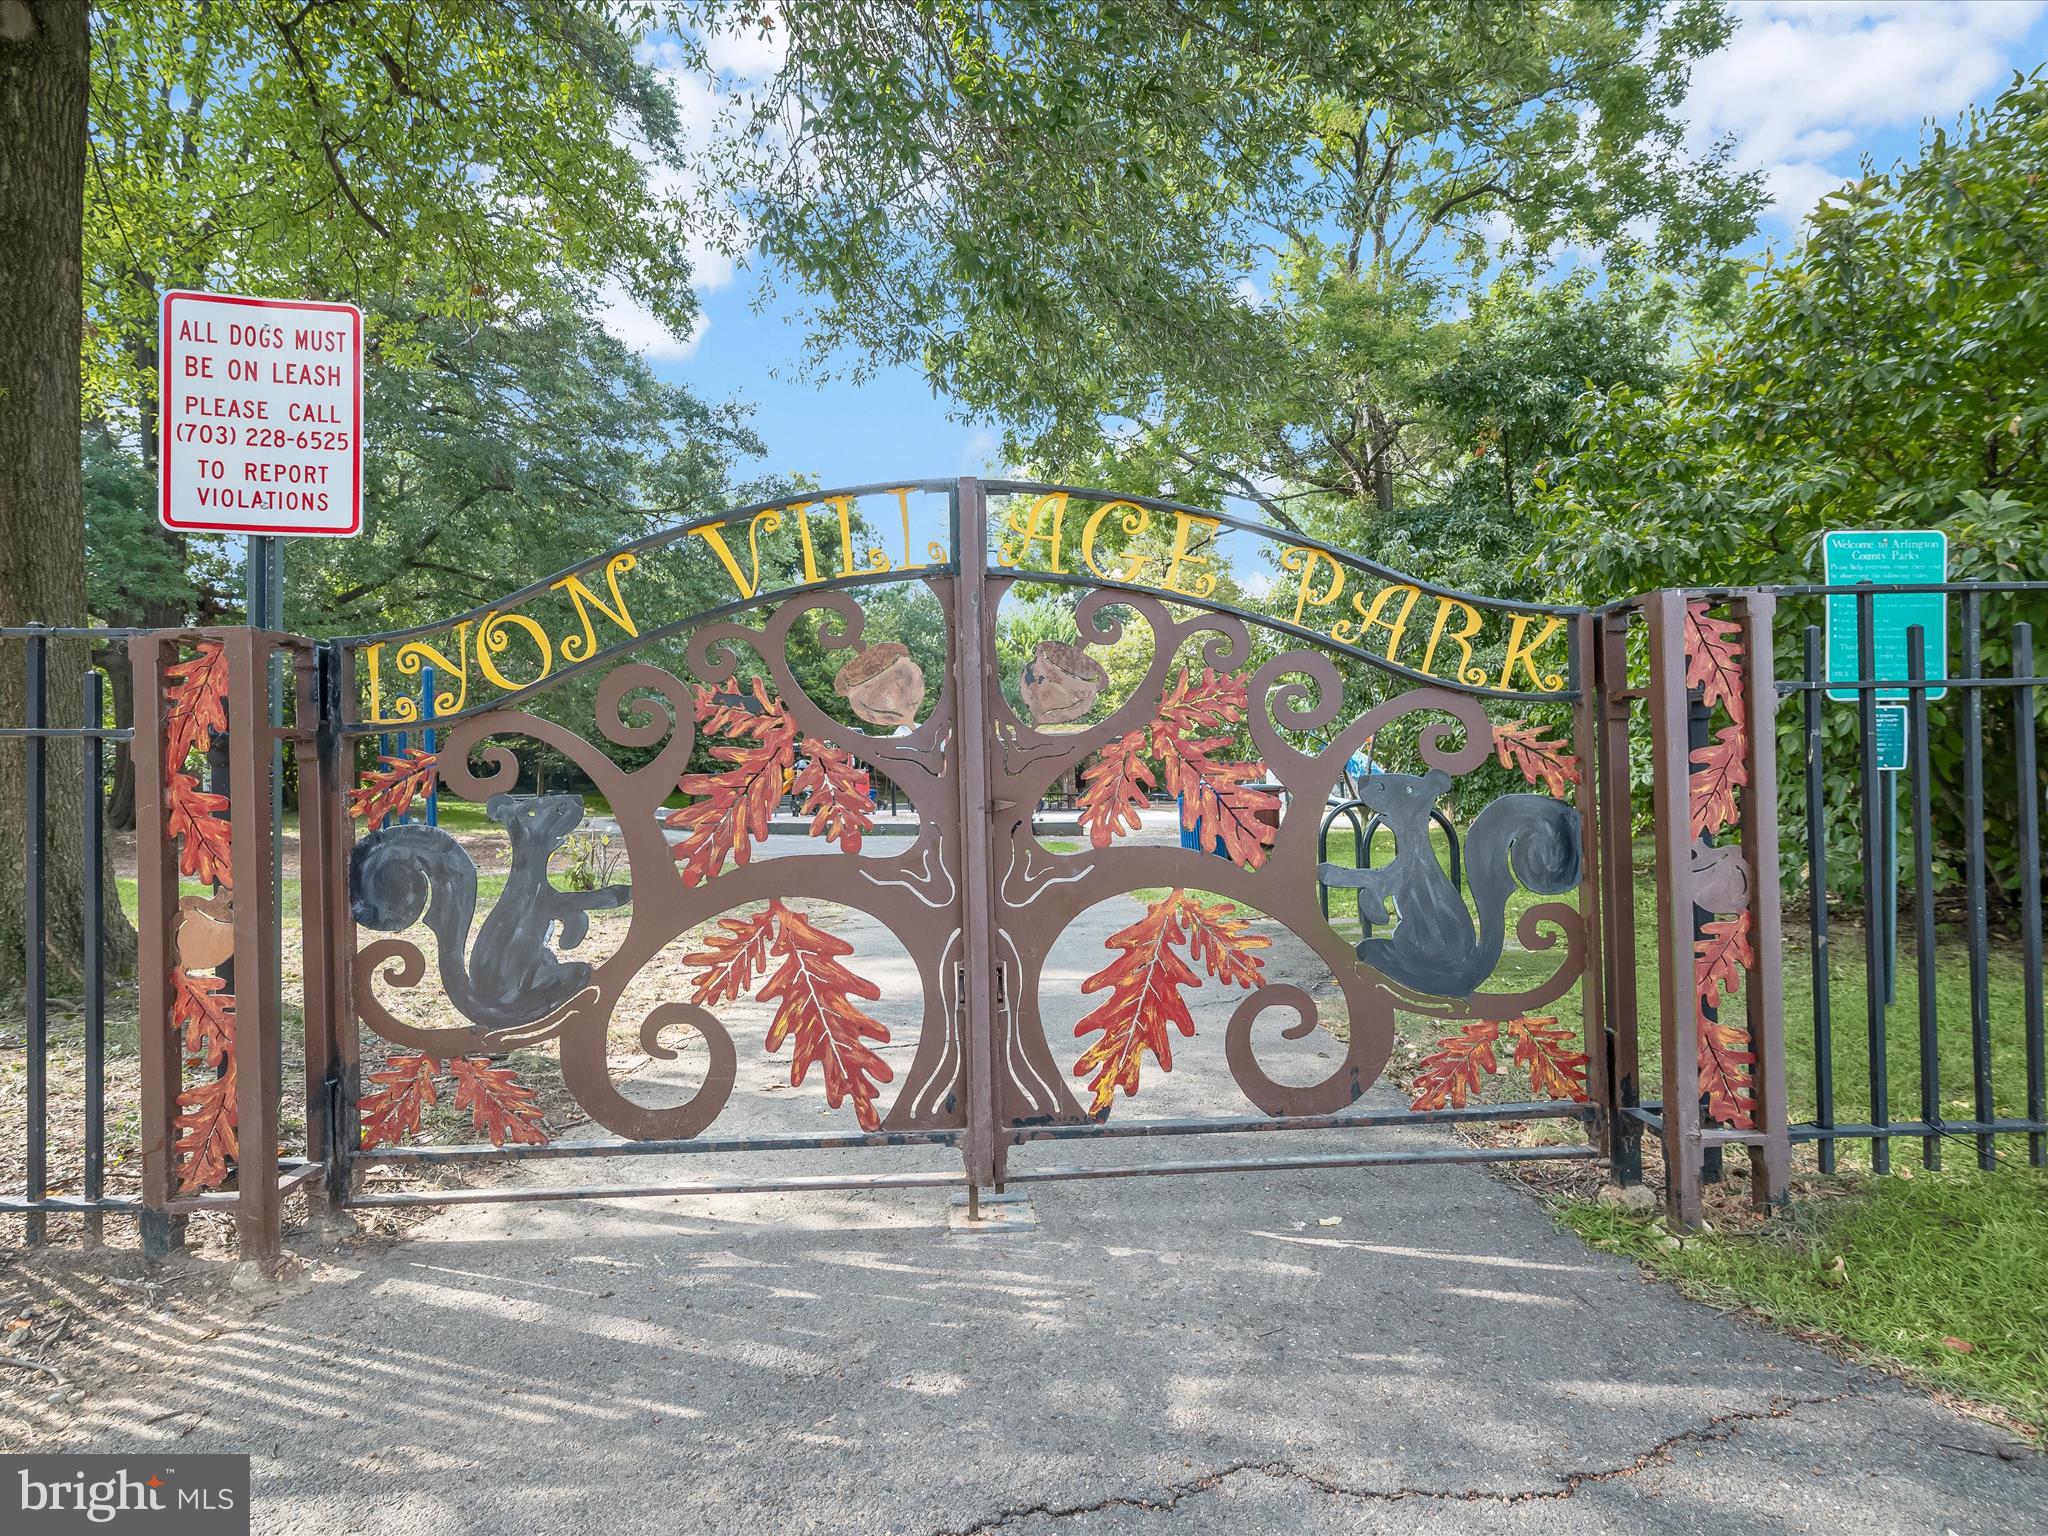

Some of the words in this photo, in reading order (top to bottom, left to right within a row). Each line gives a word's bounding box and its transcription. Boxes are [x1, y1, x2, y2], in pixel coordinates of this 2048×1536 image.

[179, 319, 217, 344] ALL
[230, 324, 283, 349] DOGS
[295, 329, 346, 353] MUST
[185, 355, 213, 378] BE
[228, 359, 258, 382] ON
[272, 362, 341, 387] LEASH
[185, 396, 268, 420] PLEASE
[289, 403, 341, 424] CALL
[176, 423, 236, 446] (703)
[246, 427, 349, 451] 228-6525
[197, 459, 224, 480] TO
[245, 462, 329, 484] REPORT
[197, 487, 329, 512] VIOLATIONS
[1831, 538, 1874, 549] Welcome
[1878, 539, 1888, 549] to
[1891, 538, 1939, 550] Arlington
[1851, 550, 1887, 562] County
[1892, 550, 1920, 560] Parks
[363, 552, 639, 725] LYON
[1279, 546, 1568, 694] PARK
